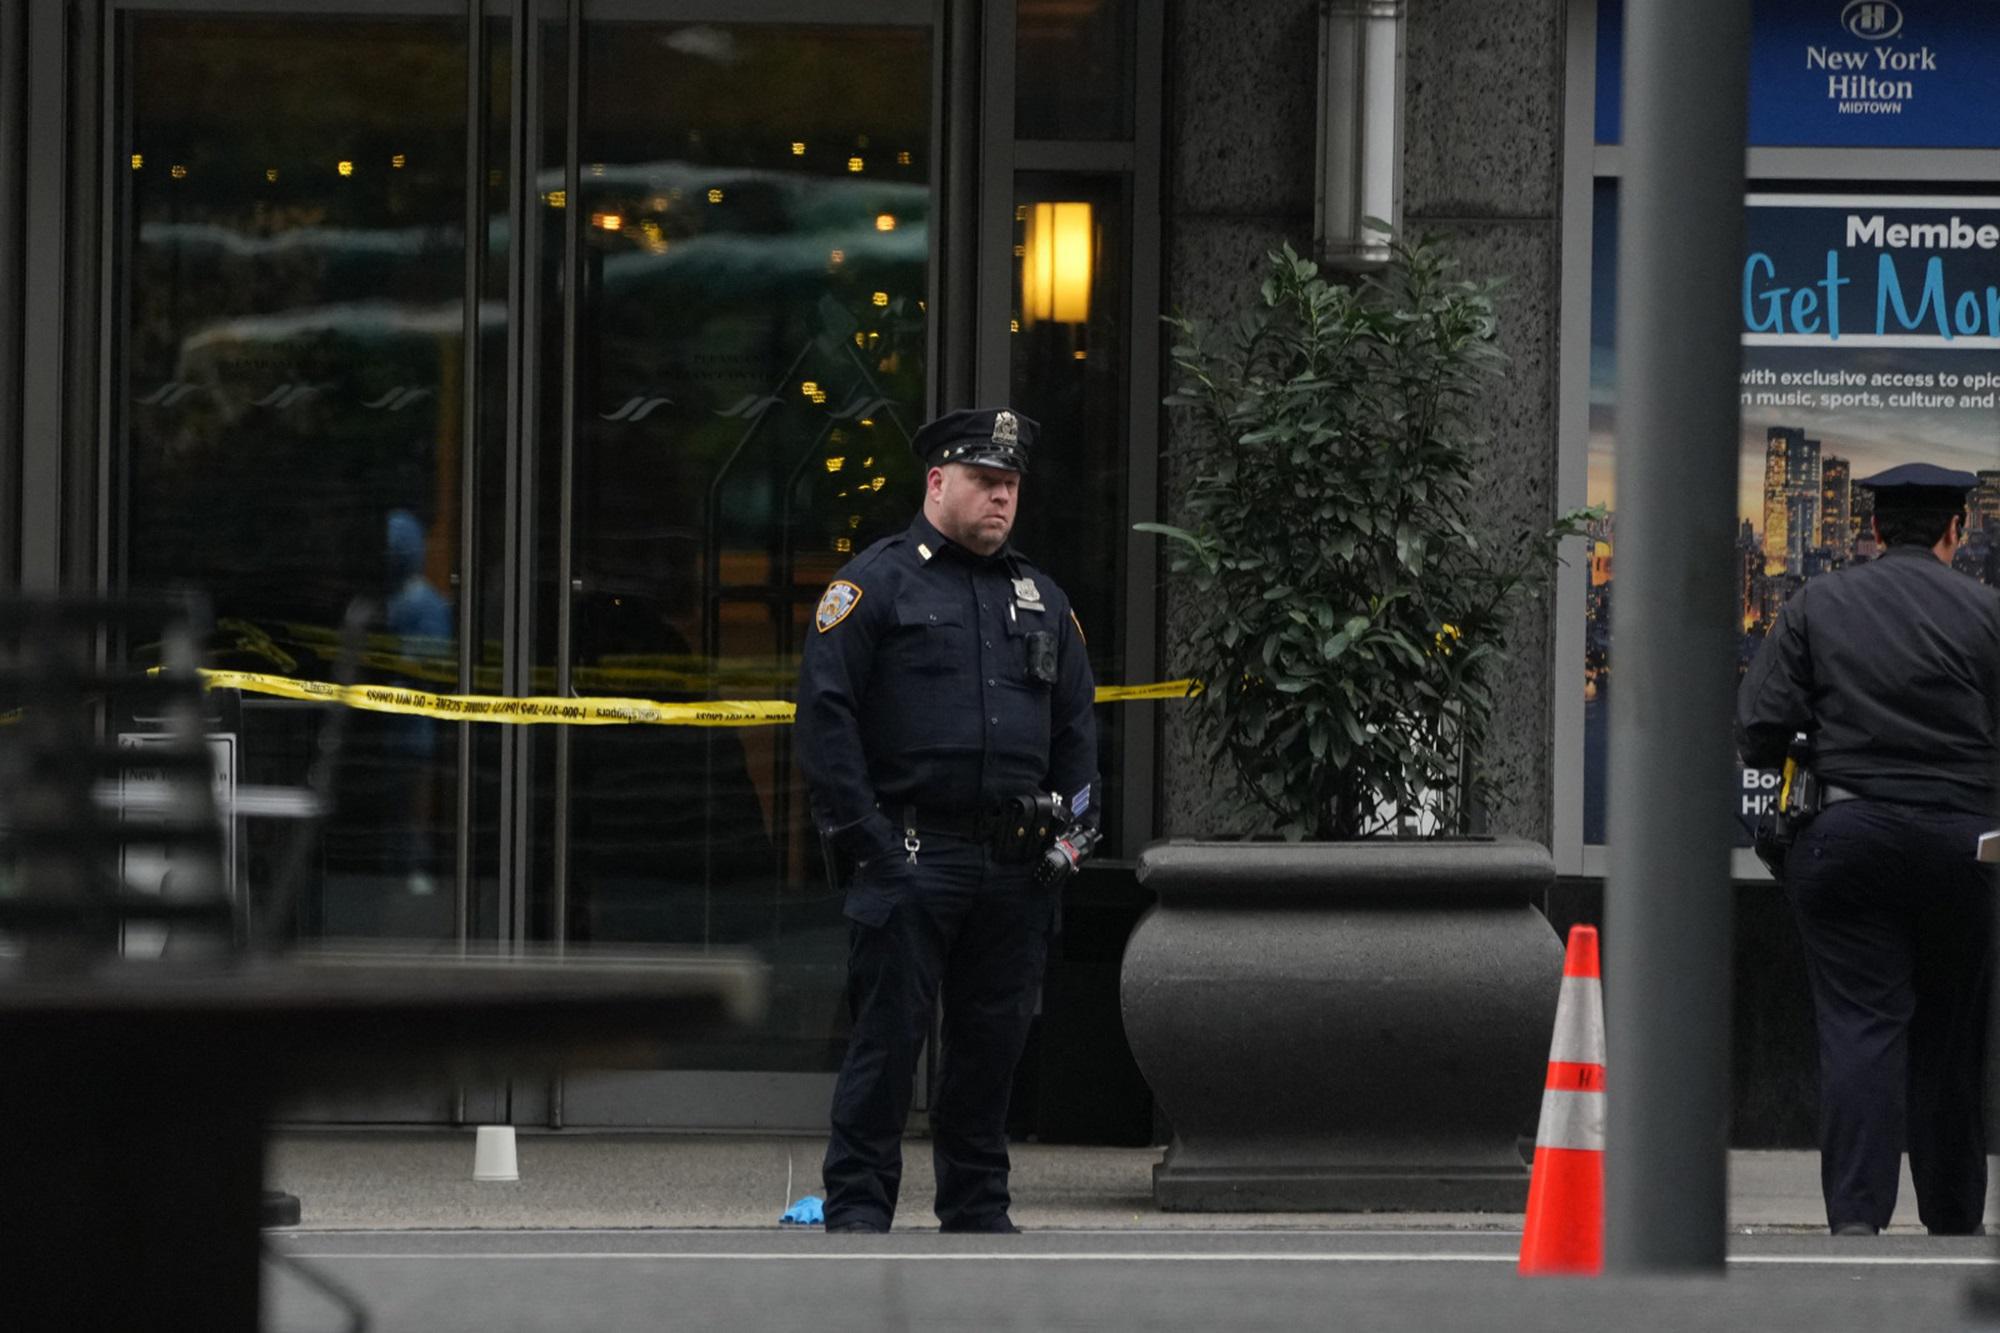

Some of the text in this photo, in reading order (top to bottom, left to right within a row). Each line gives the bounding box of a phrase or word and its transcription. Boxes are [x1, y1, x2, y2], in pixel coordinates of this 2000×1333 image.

[1806, 46, 1937, 71] New York
[1828, 75, 1913, 99] Hilton
[1838, 101, 1902, 114] MIDTOWN
[1846, 215, 1999, 249] Membe
[1743, 250, 1850, 341] Get
[1781, 370, 1867, 386] exclusive
[1871, 373, 1935, 387] access
[1938, 371, 1959, 387] to
[1963, 371, 2000, 391] epic
[1756, 390, 1816, 408] music,
[1820, 391, 1884, 410] sports,
[1888, 391, 1955, 408] culture
[1960, 392, 1994, 408] and
